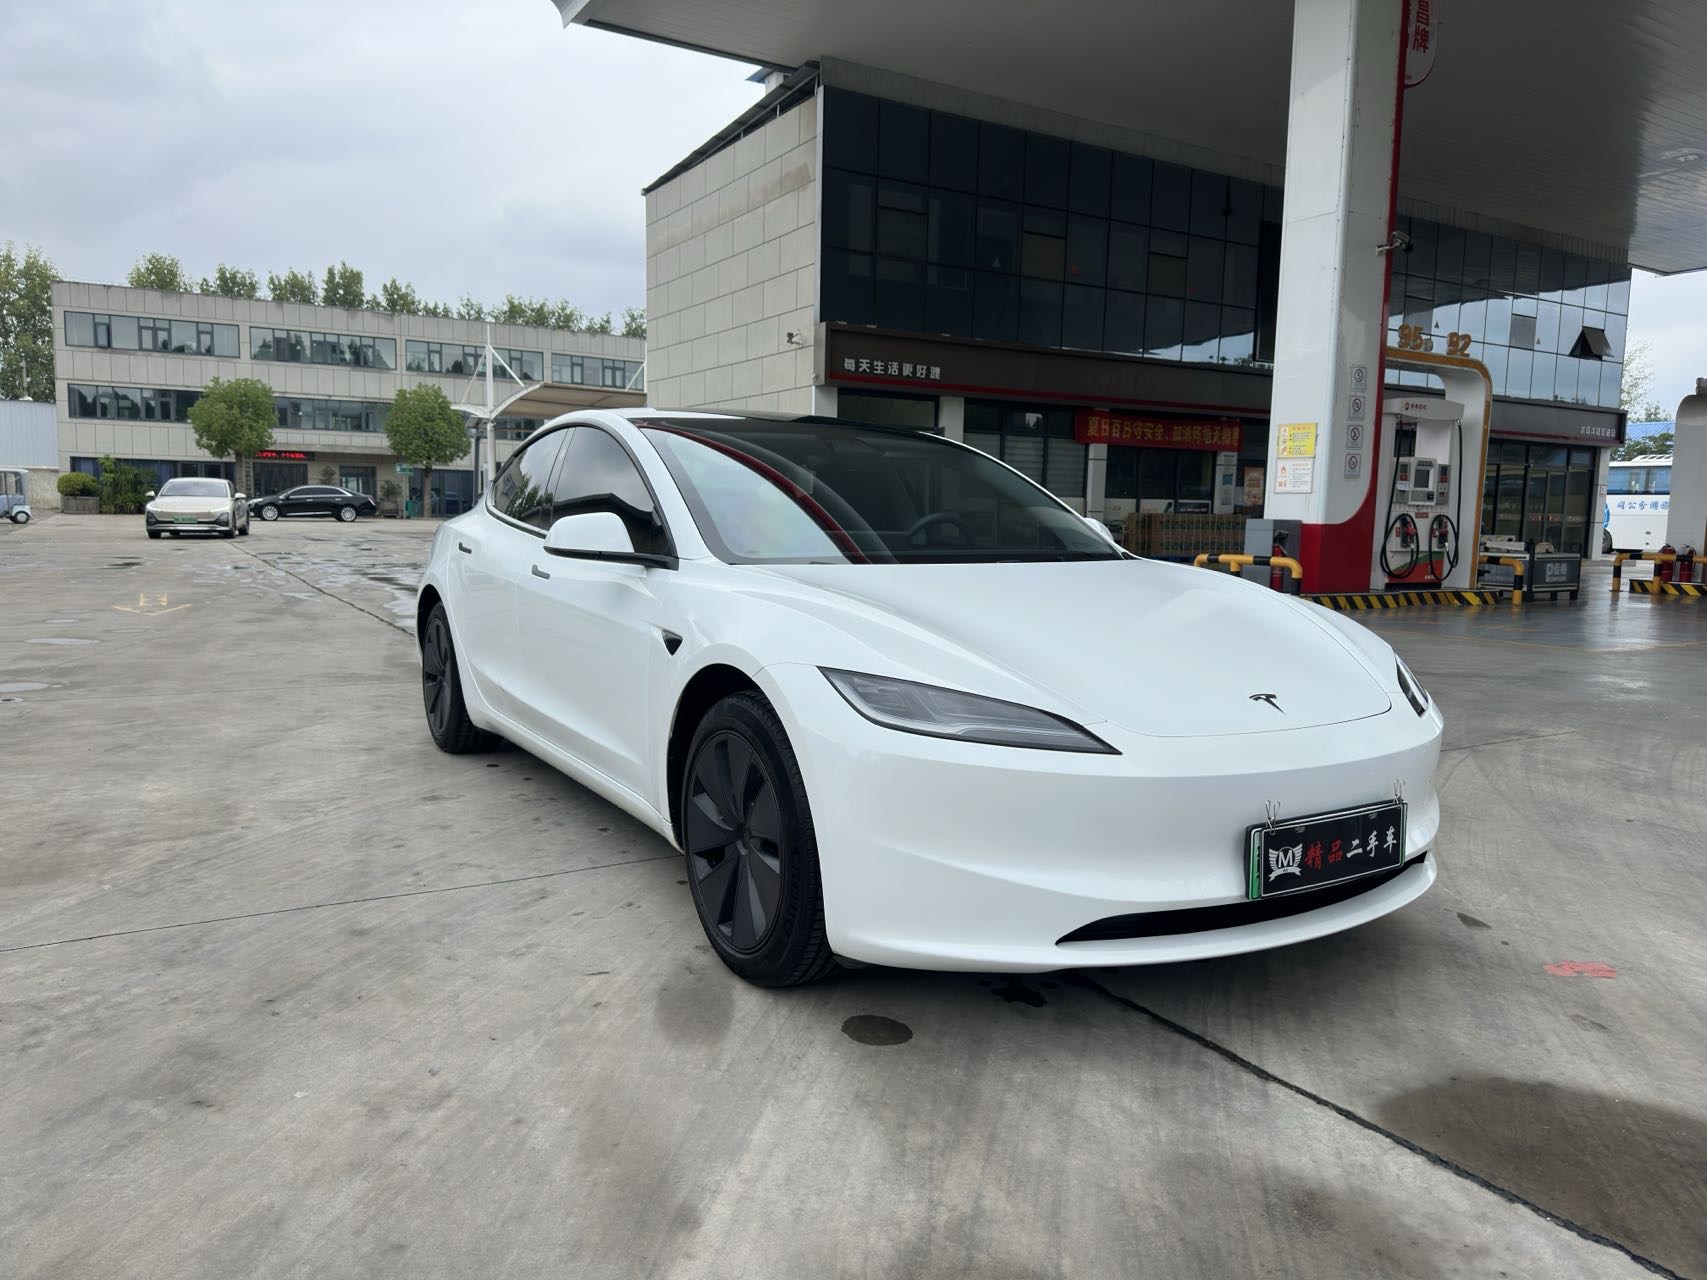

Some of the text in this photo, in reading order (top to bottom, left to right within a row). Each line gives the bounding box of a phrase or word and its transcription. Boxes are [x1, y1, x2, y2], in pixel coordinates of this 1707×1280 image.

[1446, 331, 1472, 357] 92
[1304, 826, 1397, 872] 精品二手车
